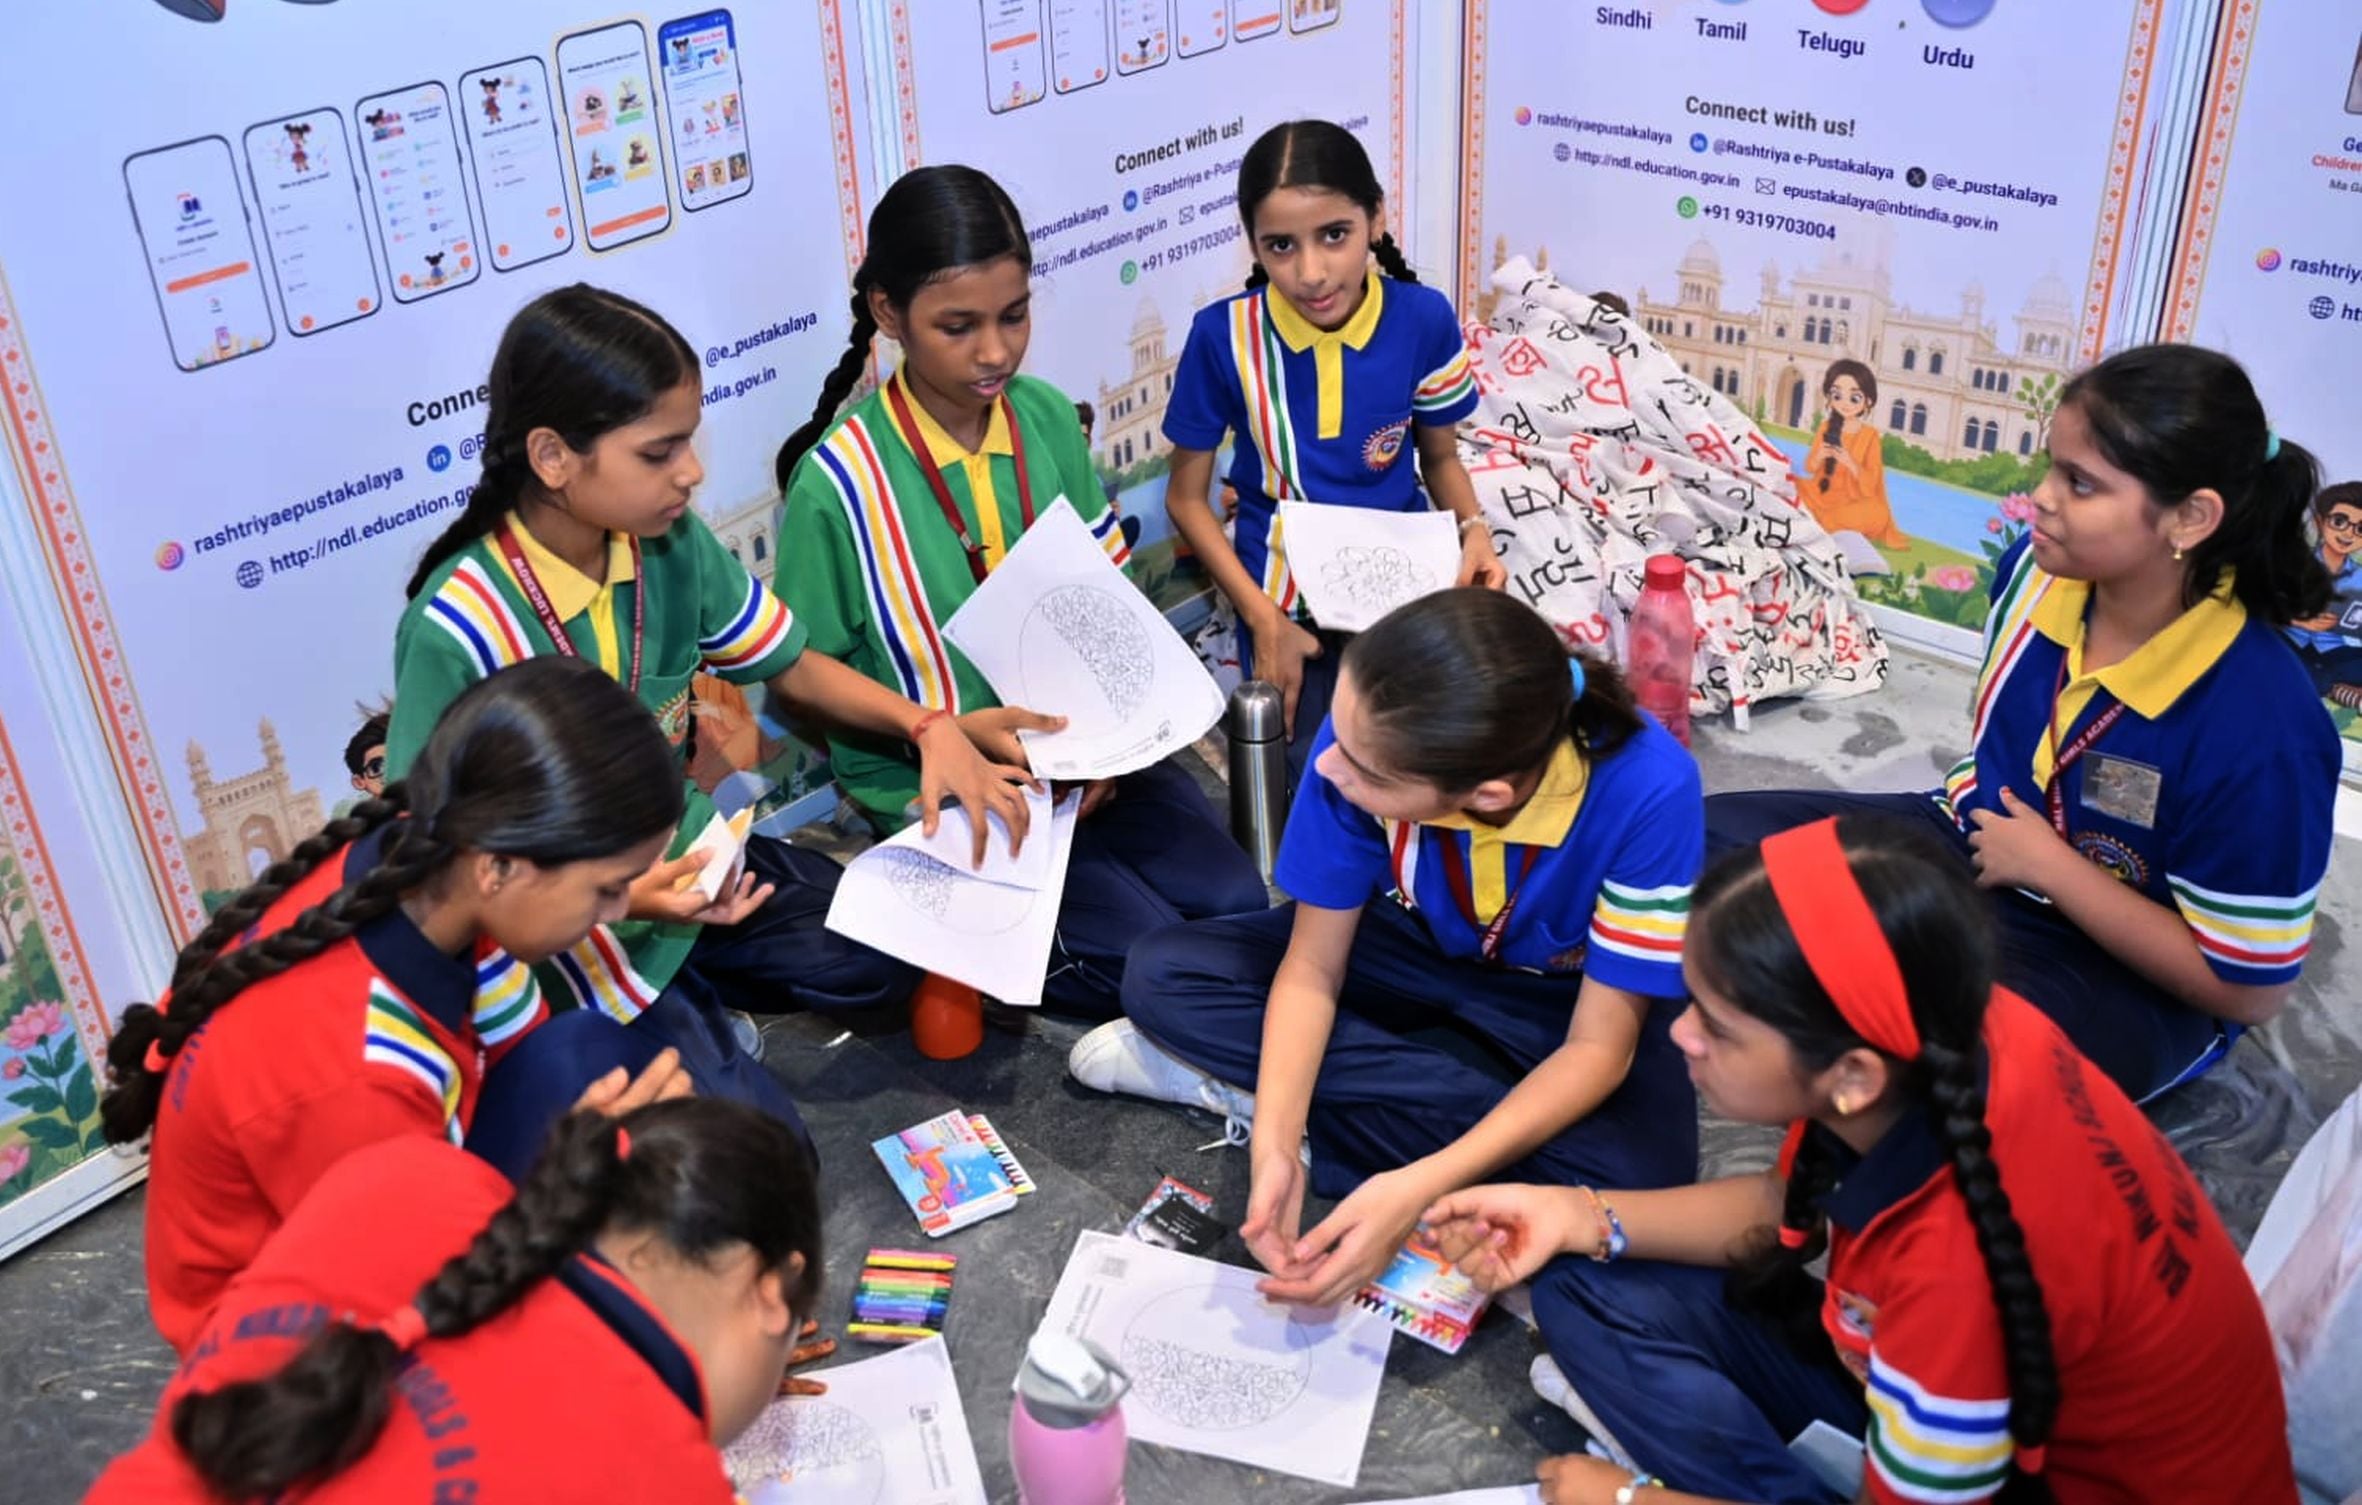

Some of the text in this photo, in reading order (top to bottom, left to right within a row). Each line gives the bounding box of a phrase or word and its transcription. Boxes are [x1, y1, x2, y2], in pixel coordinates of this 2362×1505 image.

[1596, 6, 1652, 30] Sindhi
[1696, 17, 1747, 42] Tamil
[1798, 29, 1865, 59] Telugu
[1923, 44, 1974, 69] Urdu
[1537, 112, 1673, 145] rashtriyaepustakalaya
[1685, 95, 1856, 138] Connect with us!
[1115, 116, 1244, 174] Connect with us!
[1713, 139, 1895, 180] @Rashtriya e-Pustakalaya
[1574, 148, 1740, 188] http://ndl.education.gov.in
[1142, 172, 1202, 205] @Rashtriya
[1783, 184, 1998, 232] epustakalaya@nbtindia.gov.in
[1932, 173, 2058, 207] @e_pustakalaya
[1028, 204, 1109, 242] aepustakalaya
[1703, 204, 1836, 240] +91 9319703004
[1029, 217, 1168, 278] ttp://ndl.education.gov.in
[1142, 223, 1241, 272] +91 9319703004
[2290, 257, 2362, 284] rashtriy
[706, 312, 817, 368] @e_pustakalaya
[407, 384, 490, 427] Conne
[701, 366, 777, 407] ndia.gov.in
[194, 467, 404, 554] rashtriyaepustakalaya
[270, 484, 480, 573] http://ndl.education.go
